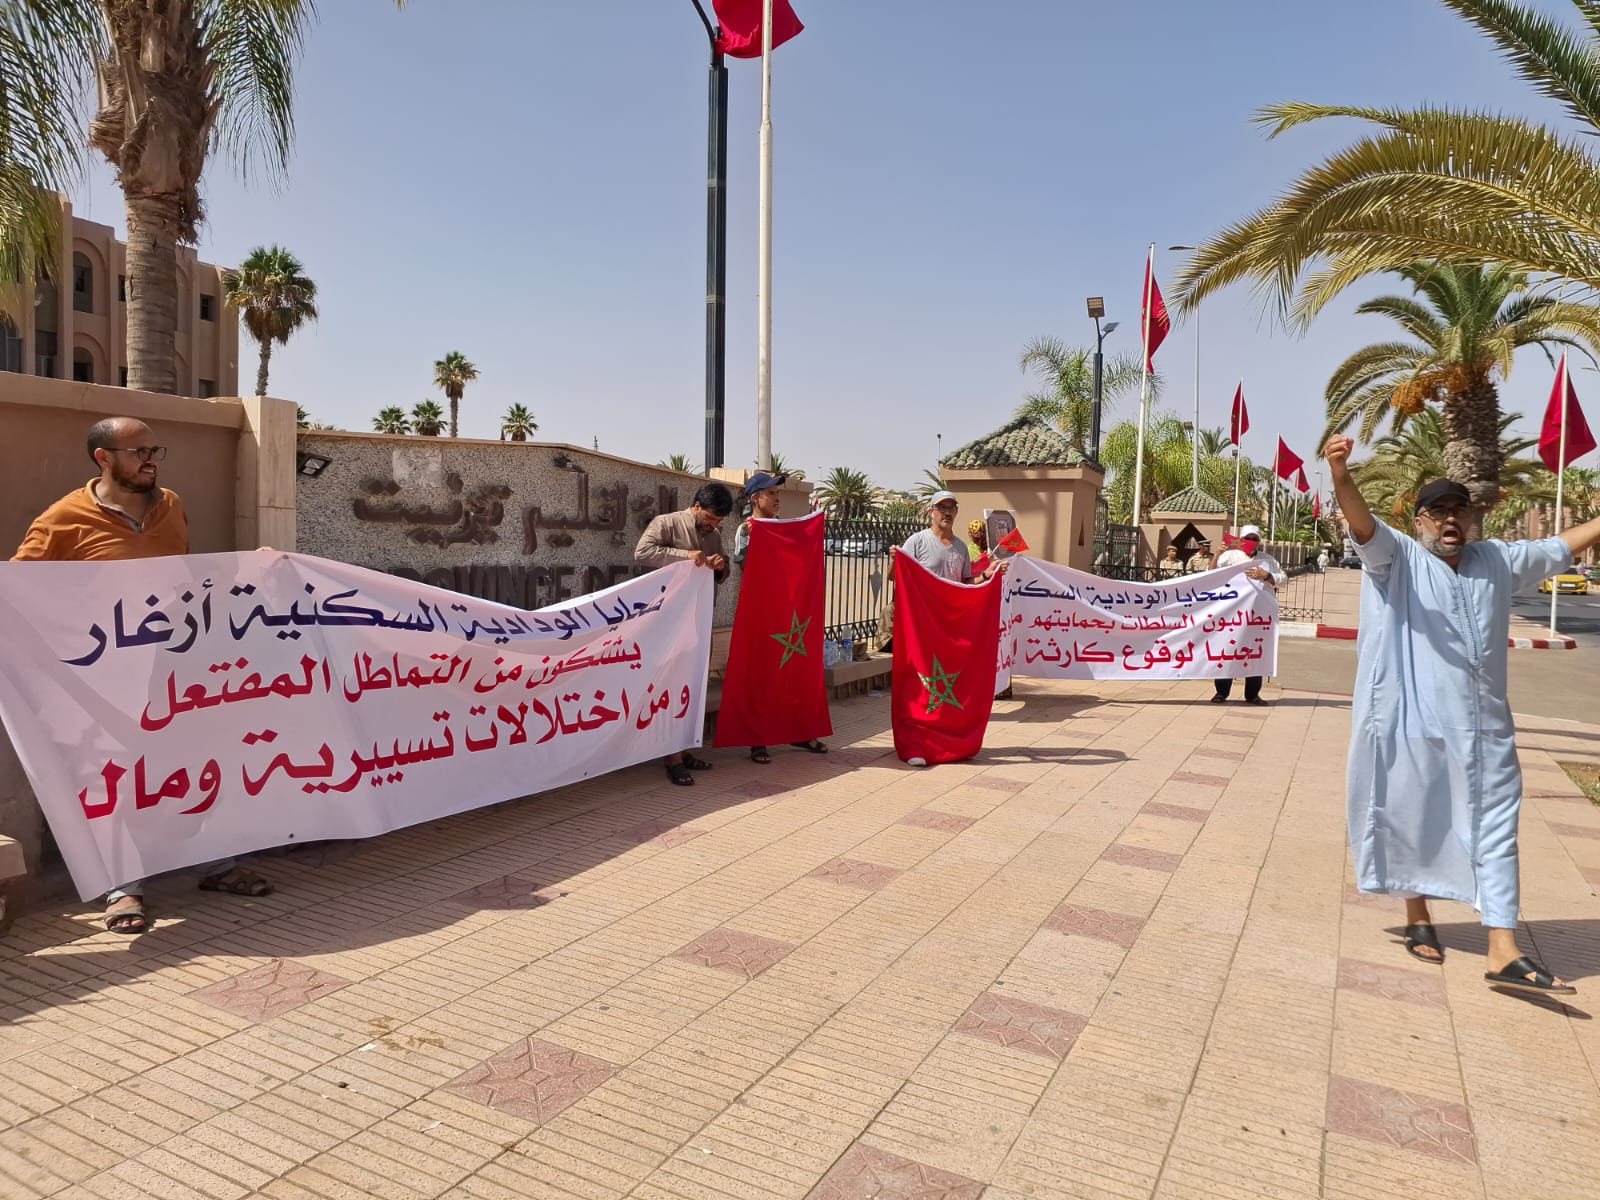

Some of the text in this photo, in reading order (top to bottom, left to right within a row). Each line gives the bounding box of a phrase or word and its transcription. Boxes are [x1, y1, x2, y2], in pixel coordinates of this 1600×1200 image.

[1085, 586, 1167, 610] الودادية
[1175, 583, 1239, 608] ضحايا
[58, 577, 667, 667] ضحايا الودادية السكنية أزغار
[1028, 609, 1116, 634] بحمايتهم
[1120, 613, 1195, 632] السلطات
[1202, 610, 1273, 633] يطالبون
[1025, 638, 1115, 669] كارثة
[1122, 639, 1195, 671] لوقوع
[1205, 637, 1264, 669] تجنبا
[139, 635, 642, 732] يشتكون من التماطل المفتعل
[465, 686, 630, 753] اختلالات
[241, 709, 455, 797] تسييرية
